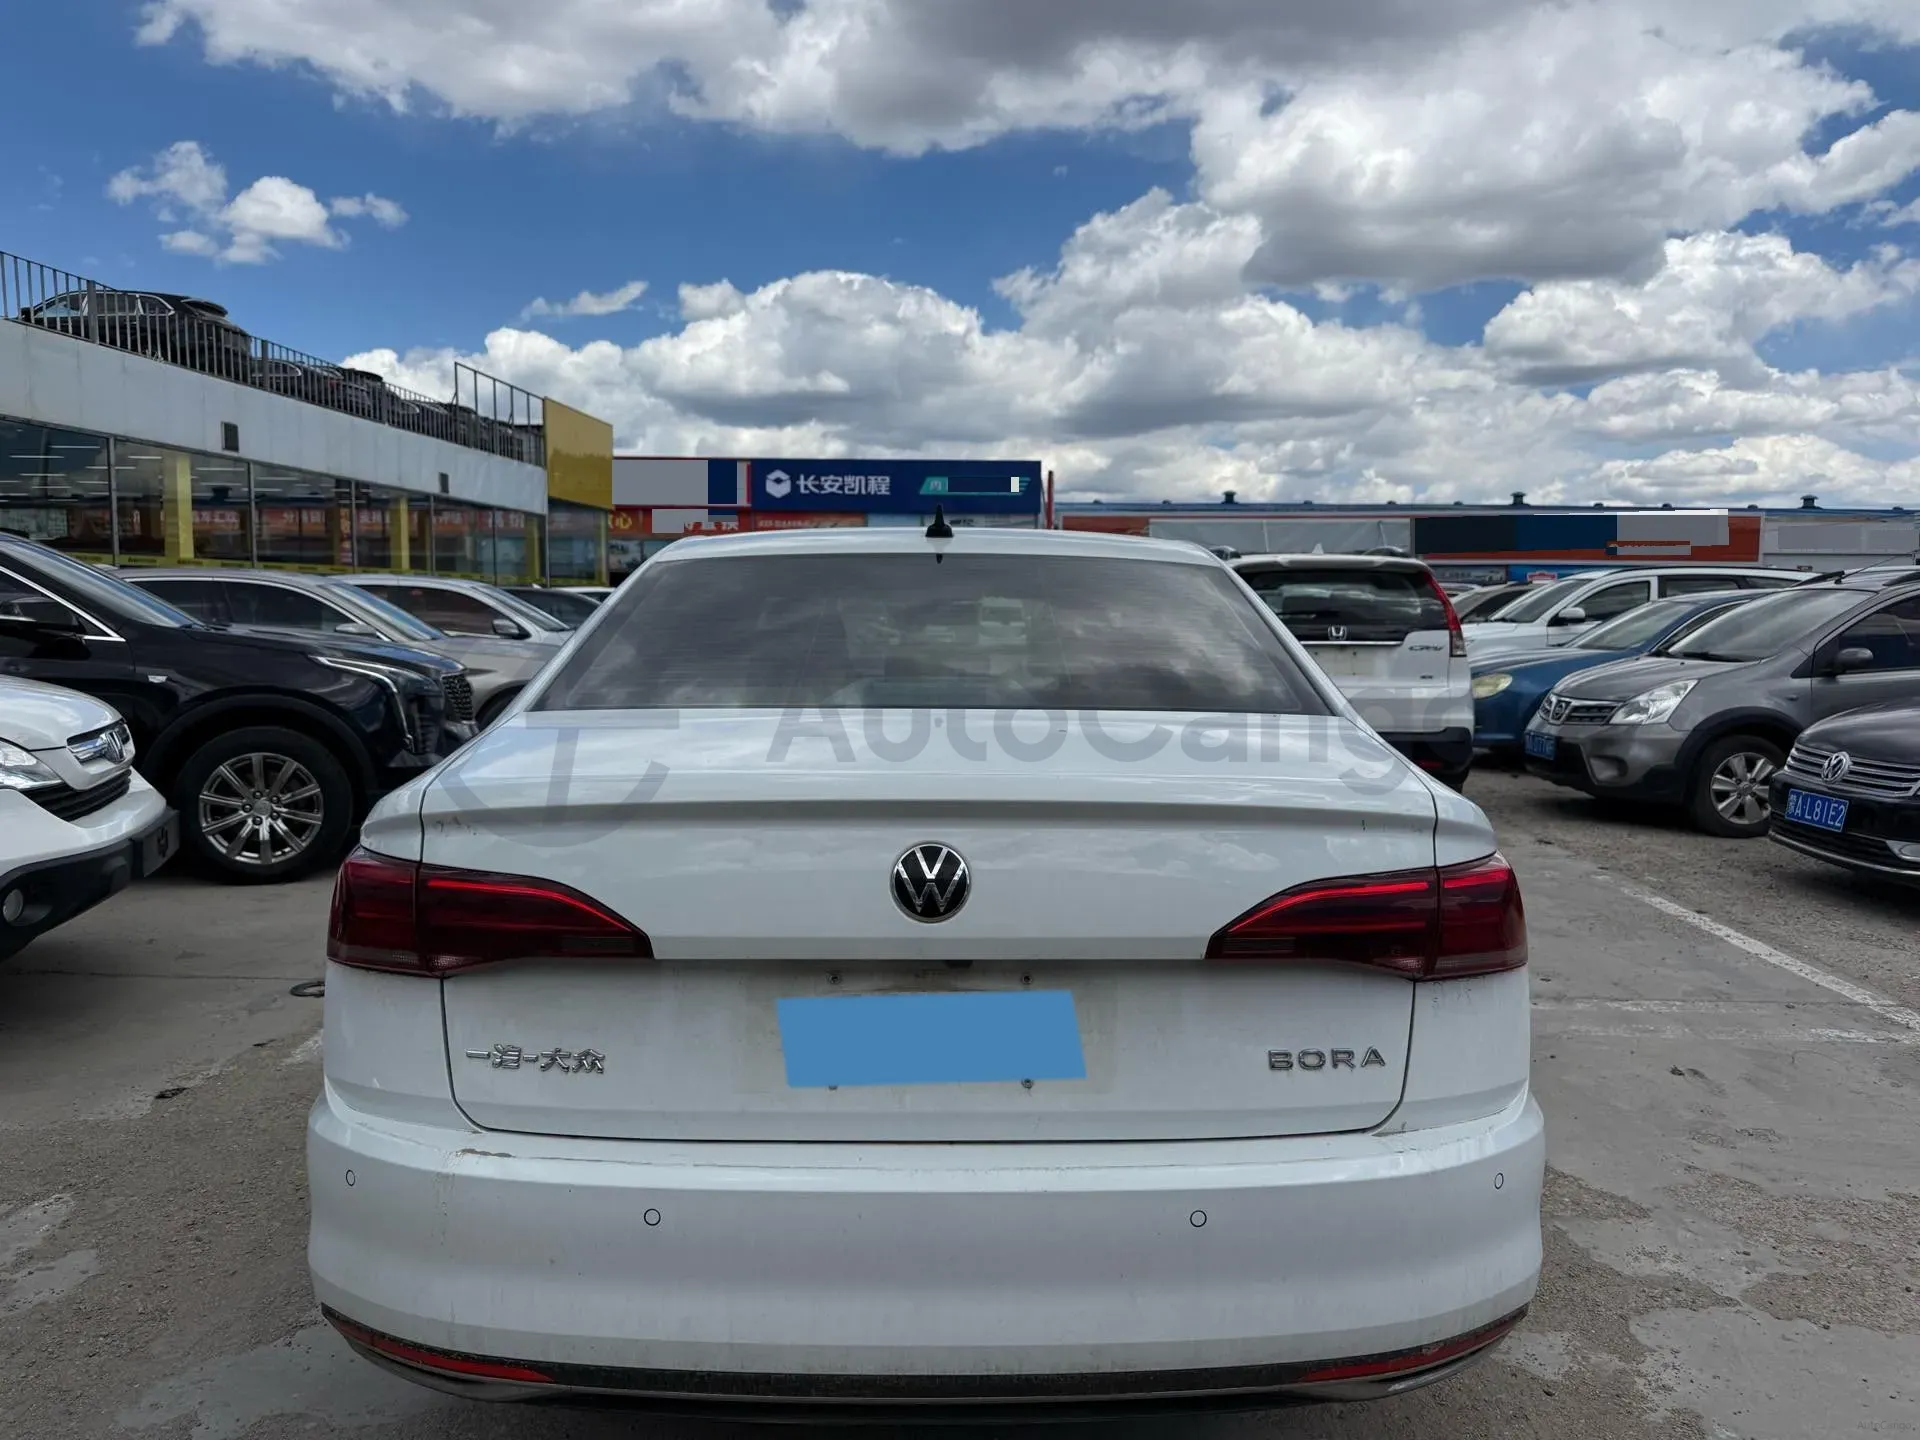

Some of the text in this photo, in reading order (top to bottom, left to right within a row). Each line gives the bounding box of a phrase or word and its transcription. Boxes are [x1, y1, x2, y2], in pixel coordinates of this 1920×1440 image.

[796, 474, 892, 496] 长安凯程
[1267, 1045, 1387, 1071] BORA
